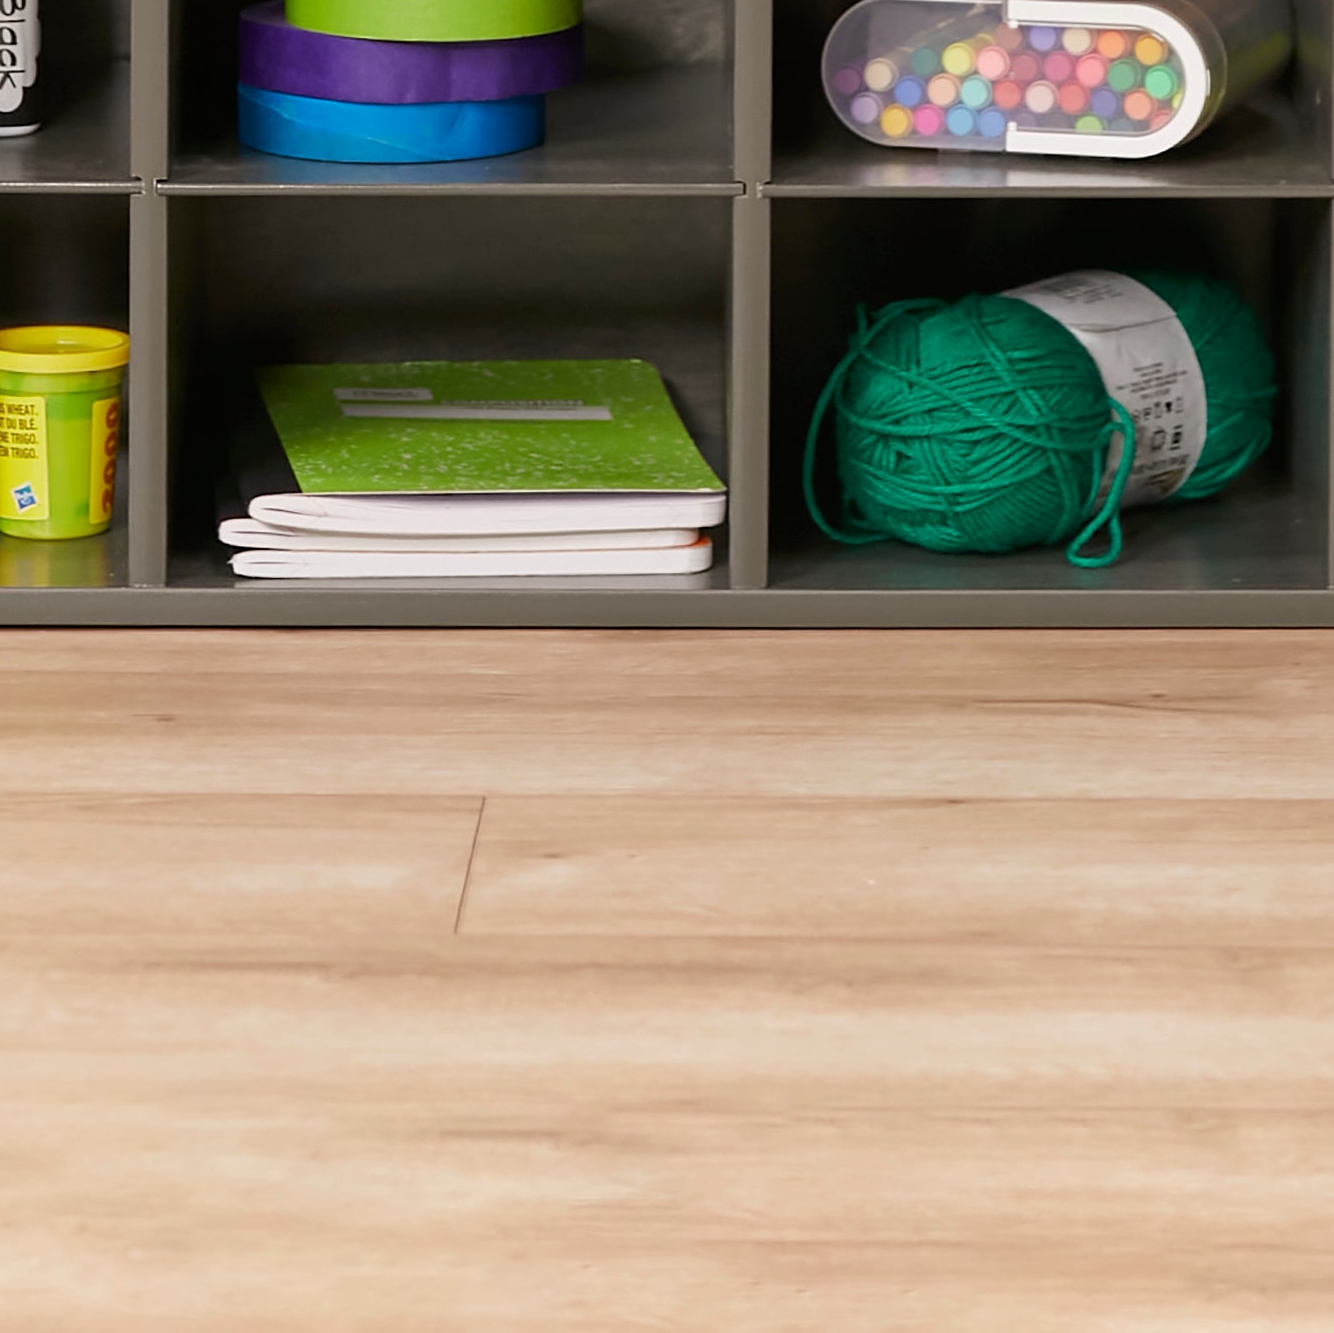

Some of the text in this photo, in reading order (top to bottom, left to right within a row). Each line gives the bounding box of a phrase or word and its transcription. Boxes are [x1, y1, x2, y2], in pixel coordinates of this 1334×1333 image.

[7, 403, 39, 417] WHEAT.
[6, 418, 17, 430] DU
[11, 432, 39, 445] TRIGO.
[11, 447, 40, 460] TRIGO.
